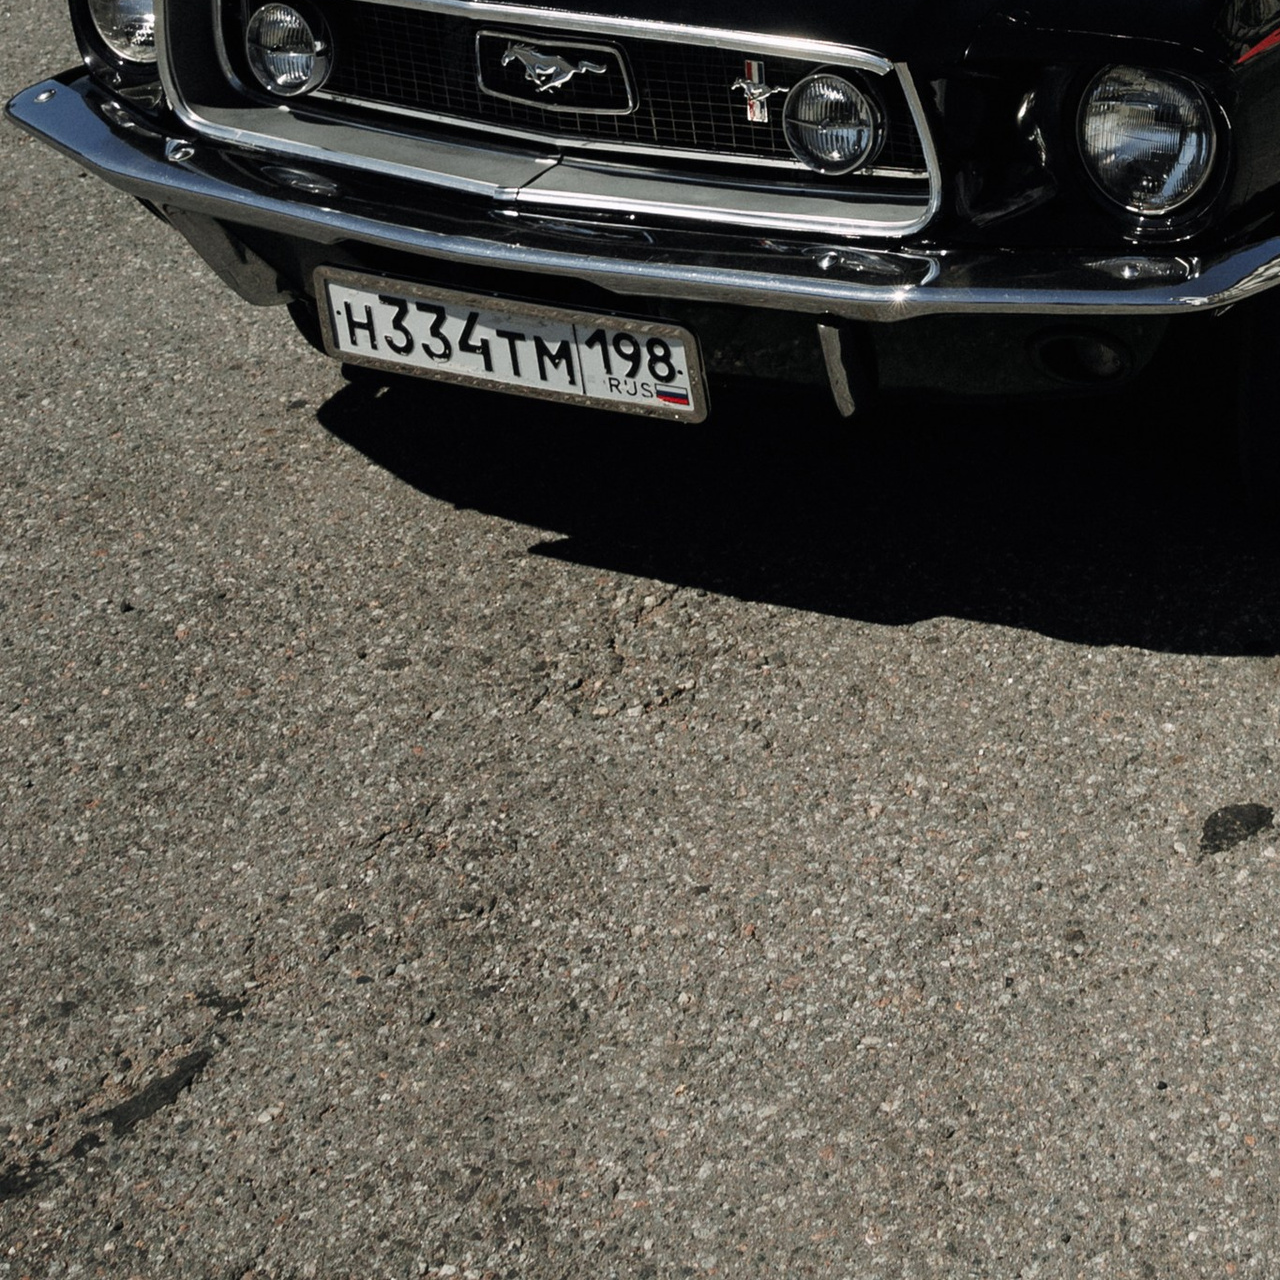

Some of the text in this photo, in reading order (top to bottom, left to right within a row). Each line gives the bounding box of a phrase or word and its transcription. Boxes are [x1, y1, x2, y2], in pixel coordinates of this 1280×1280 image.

[344, 293, 677, 385] Н334ТМ 198
[608, 377, 655, 399] RUS
